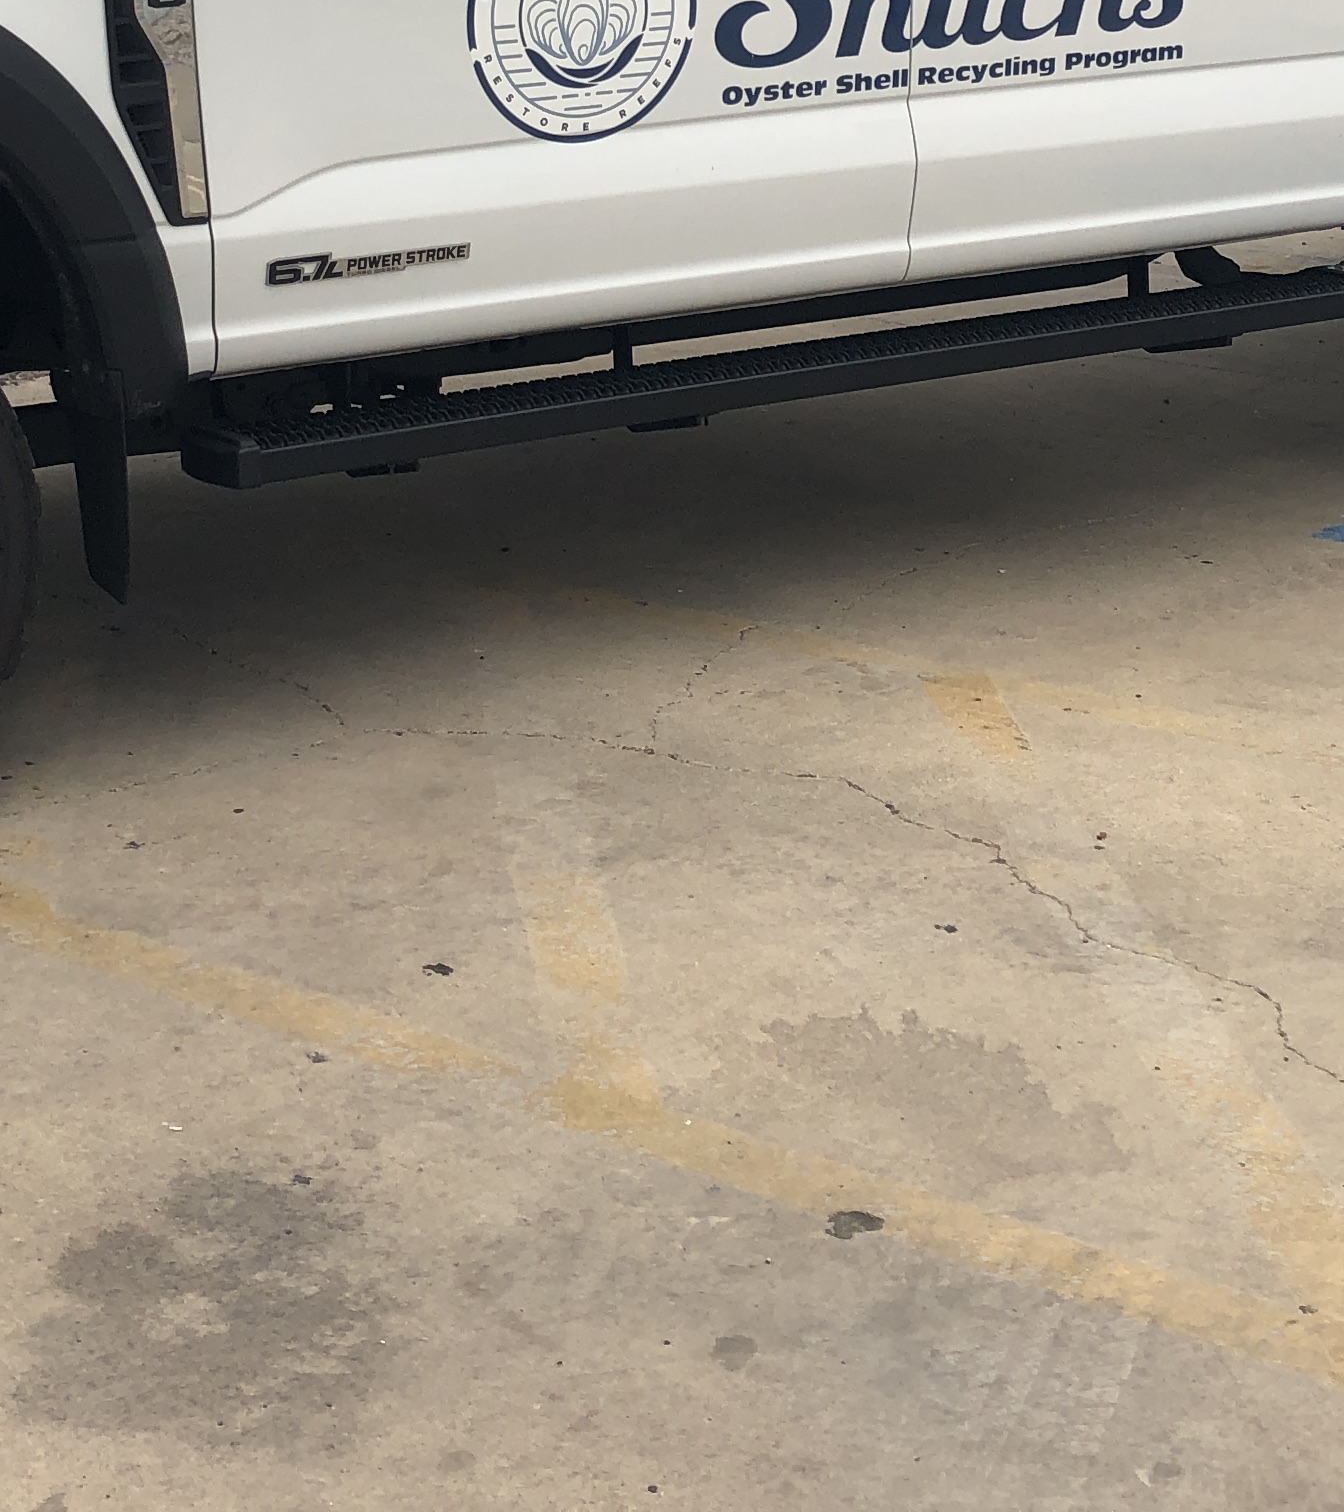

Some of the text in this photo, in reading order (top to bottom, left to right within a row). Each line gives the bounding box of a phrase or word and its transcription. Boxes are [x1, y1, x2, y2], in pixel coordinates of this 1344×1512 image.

[484, 38, 681, 132] RESTORE REEFS
[722, 44, 1183, 107] Oyster Shell Recycling Program
[346, 253, 402, 272] POWER
[406, 245, 468, 264] STROKE
